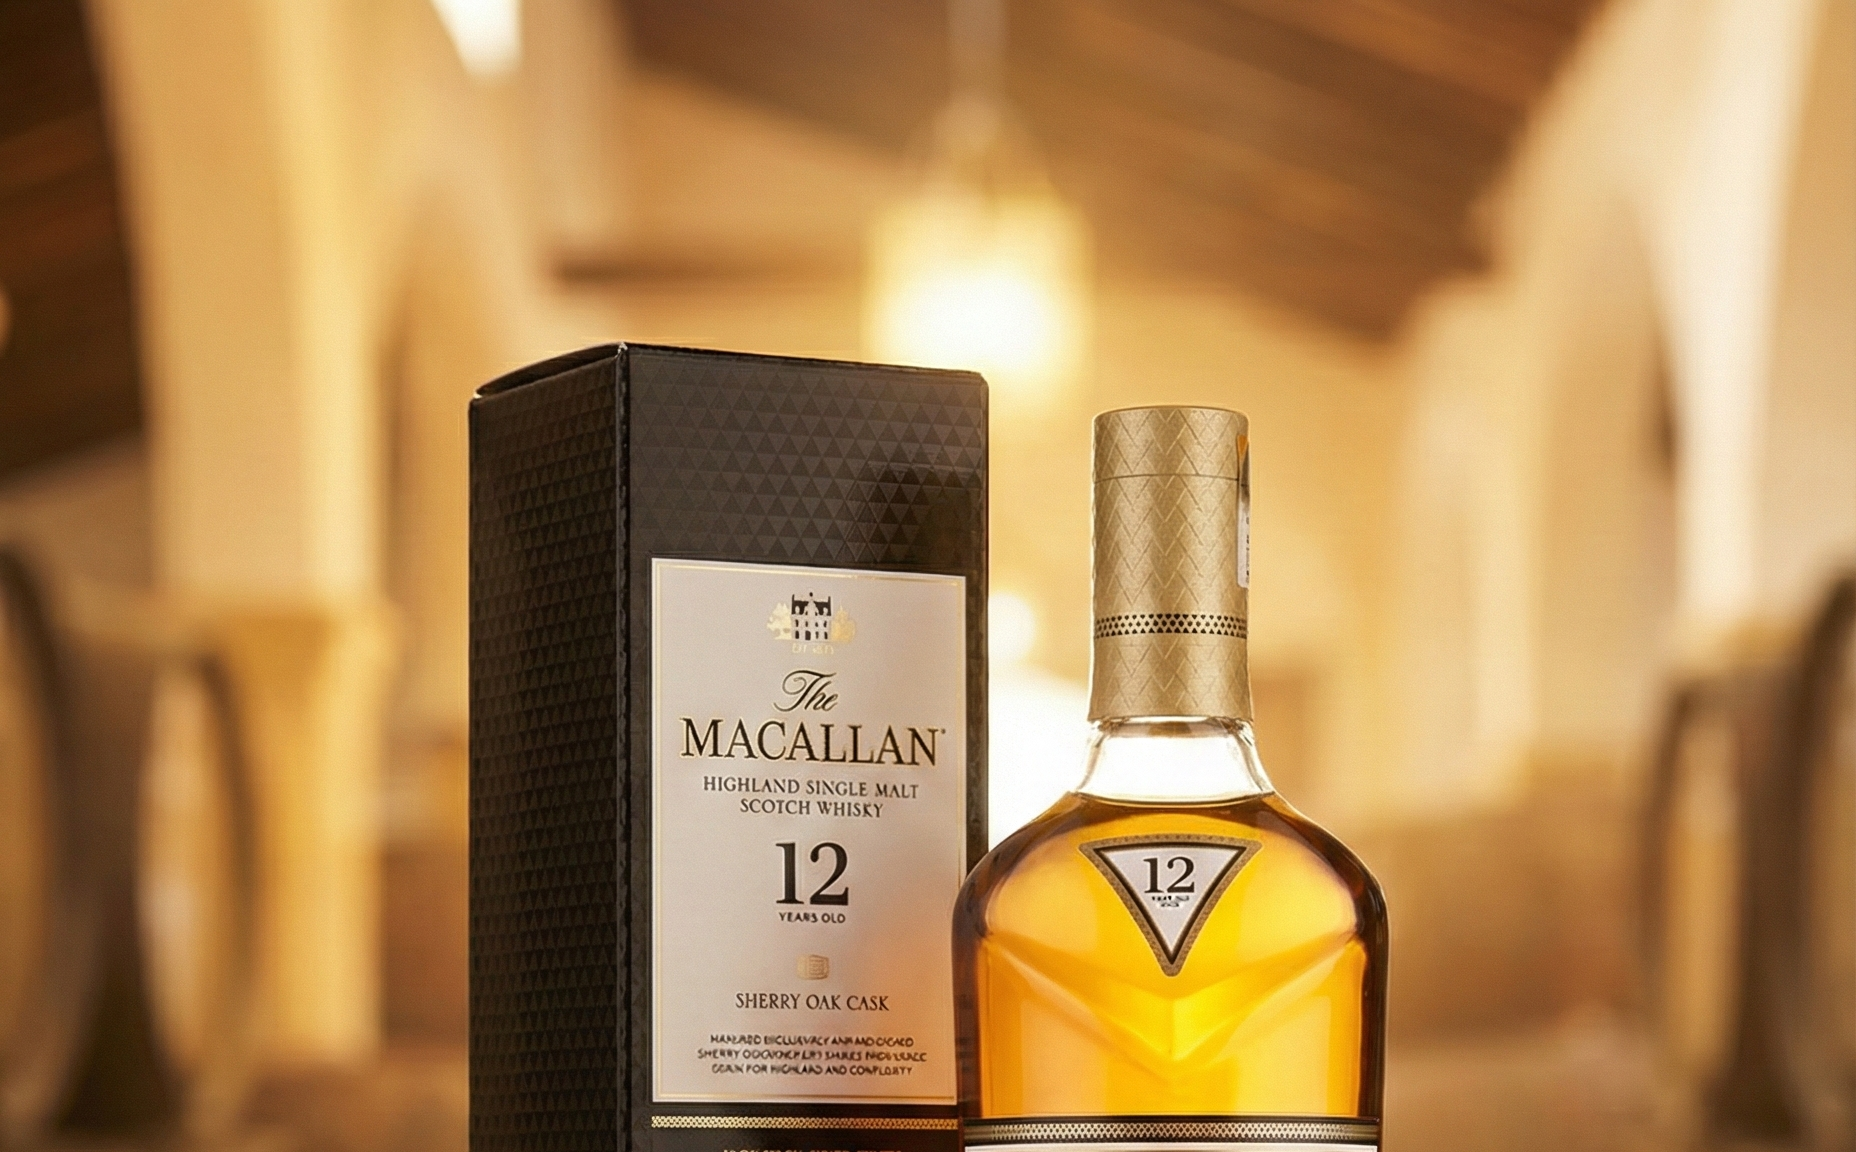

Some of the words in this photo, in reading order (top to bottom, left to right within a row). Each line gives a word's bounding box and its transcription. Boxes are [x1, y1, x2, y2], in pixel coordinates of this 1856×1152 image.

[774, 669, 838, 712] The
[680, 717, 945, 767] MACALLAN
[704, 776, 800, 795] HIGHLAND
[806, 779, 868, 798] SINGLE
[875, 782, 919, 800] MALT
[740, 798, 811, 816] SCOTCH
[817, 801, 884, 818] WHISKY
[775, 841, 850, 907] 12
[1143, 856, 1195, 893] 12
[779, 911, 818, 923] YEARS
[821, 912, 846, 924] OLD
[735, 992, 801, 1009] SHERRY
[806, 993, 842, 1011] OAK
[846, 995, 890, 1012] CASK
